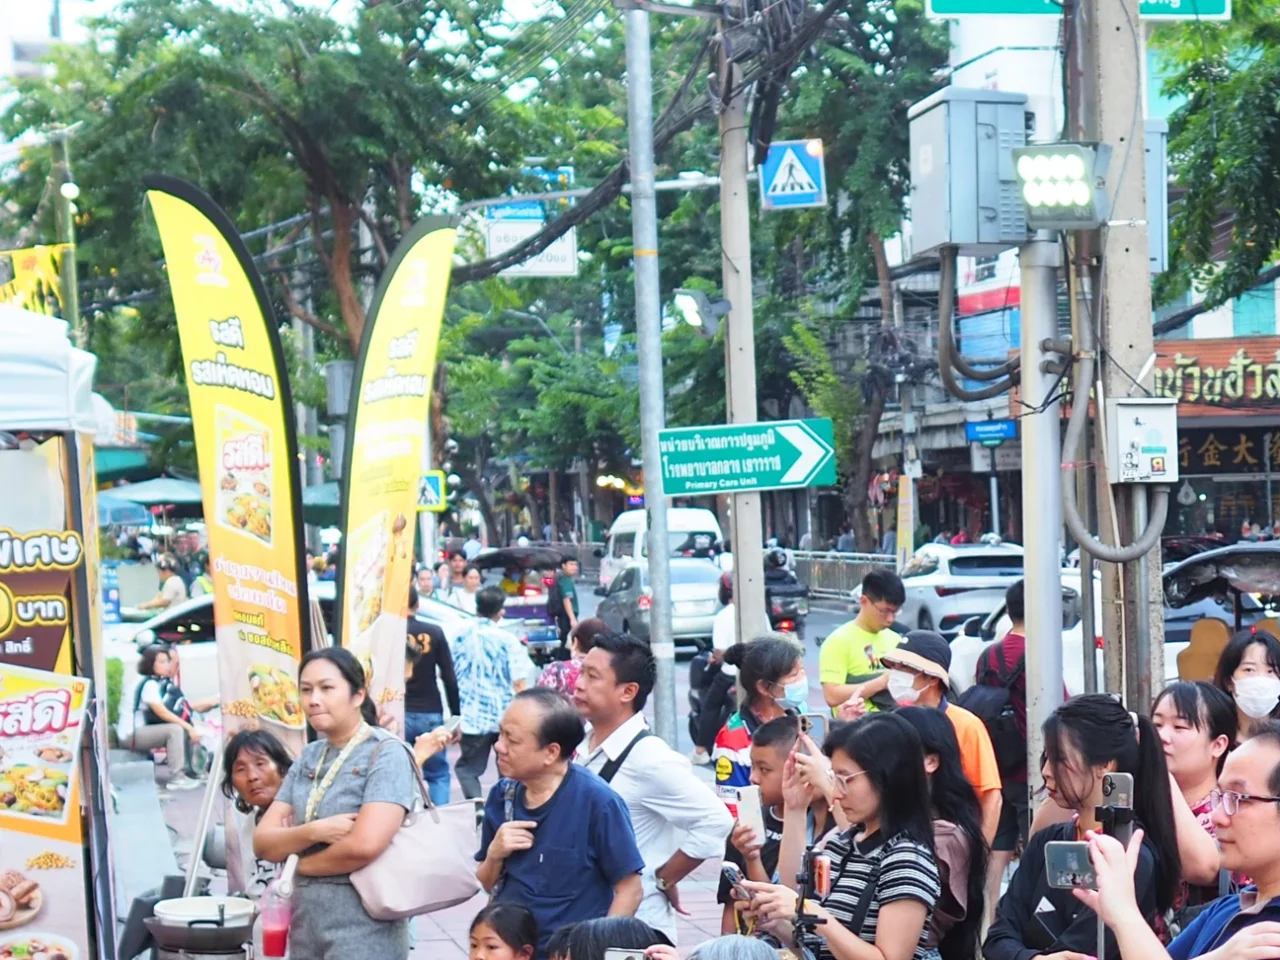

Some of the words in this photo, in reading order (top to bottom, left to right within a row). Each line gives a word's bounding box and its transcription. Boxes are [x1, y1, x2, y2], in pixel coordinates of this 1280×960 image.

[685, 480, 717, 490] Primary
[719, 478, 738, 488] Care
[740, 477, 757, 486] Unit
[16, 600, 65, 620] บาท
[0, 689, 72, 737] สดี
